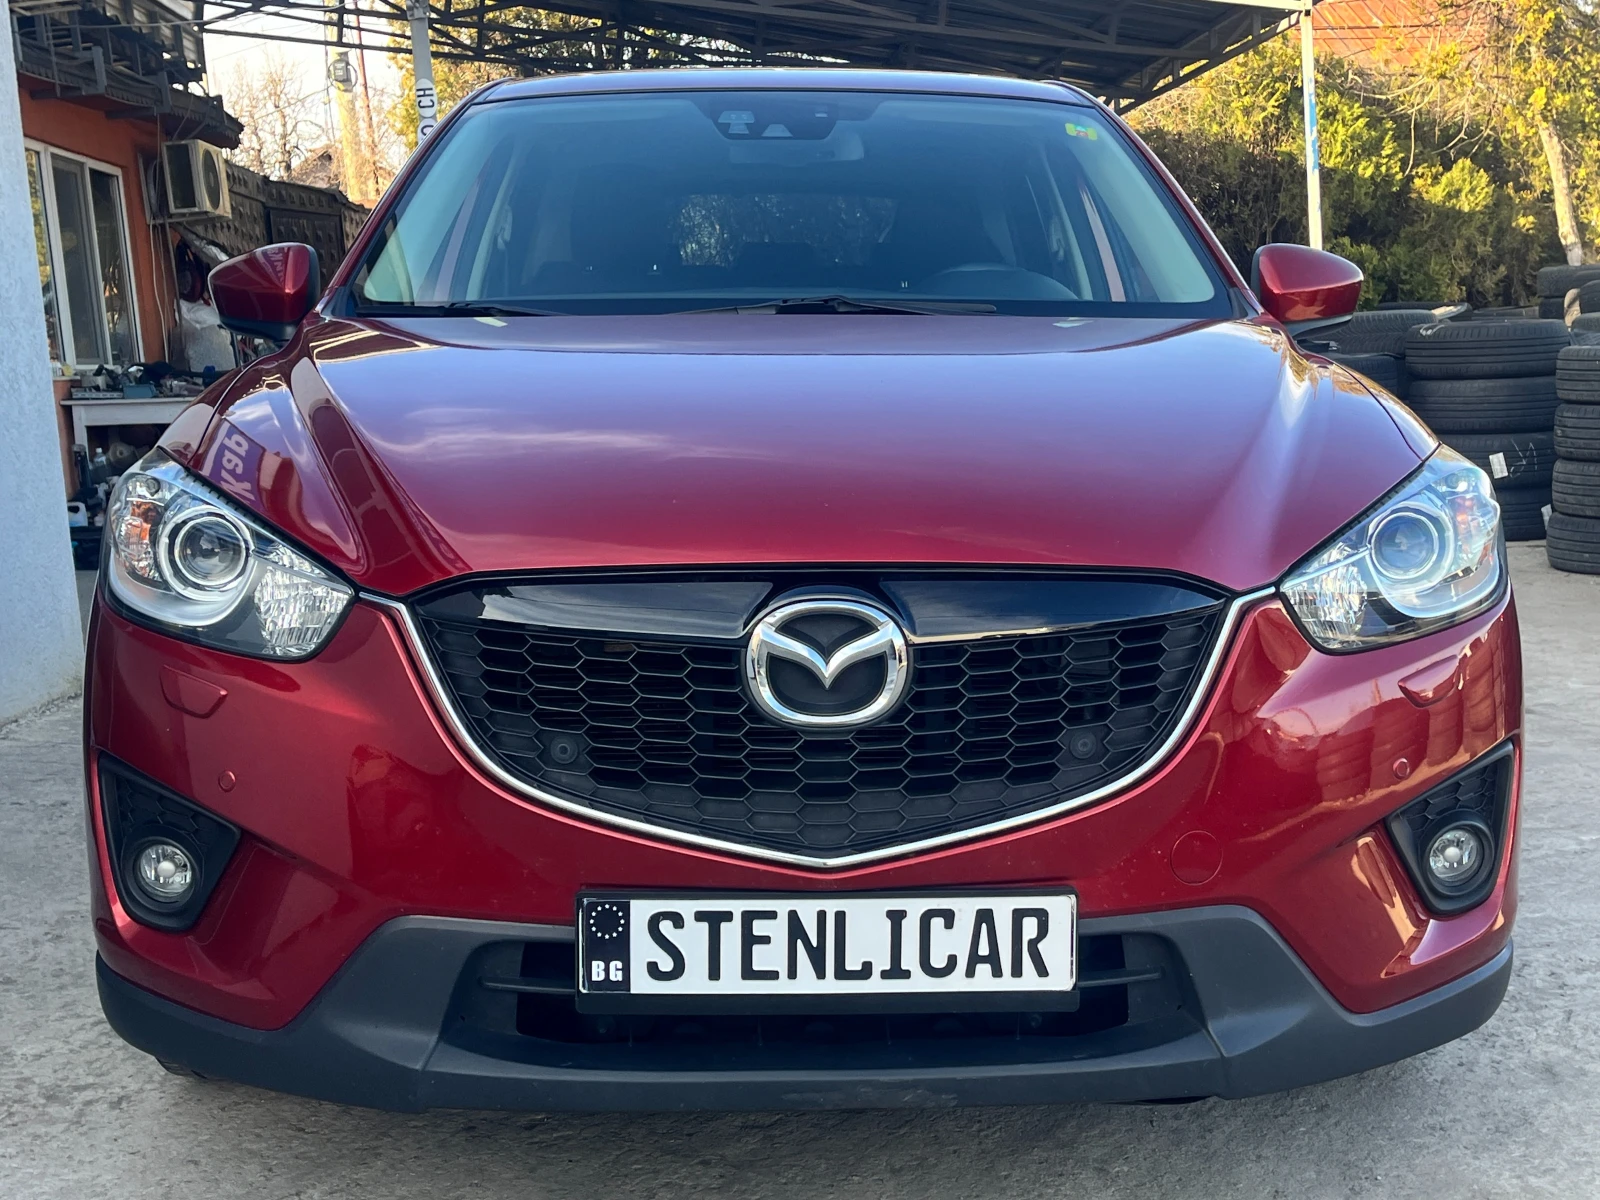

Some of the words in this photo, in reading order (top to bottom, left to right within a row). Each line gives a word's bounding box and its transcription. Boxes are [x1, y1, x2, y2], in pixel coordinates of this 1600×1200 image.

[416, 87, 435, 109] CH
[646, 907, 1050, 982] STENLICAR
[591, 960, 623, 982] BG
